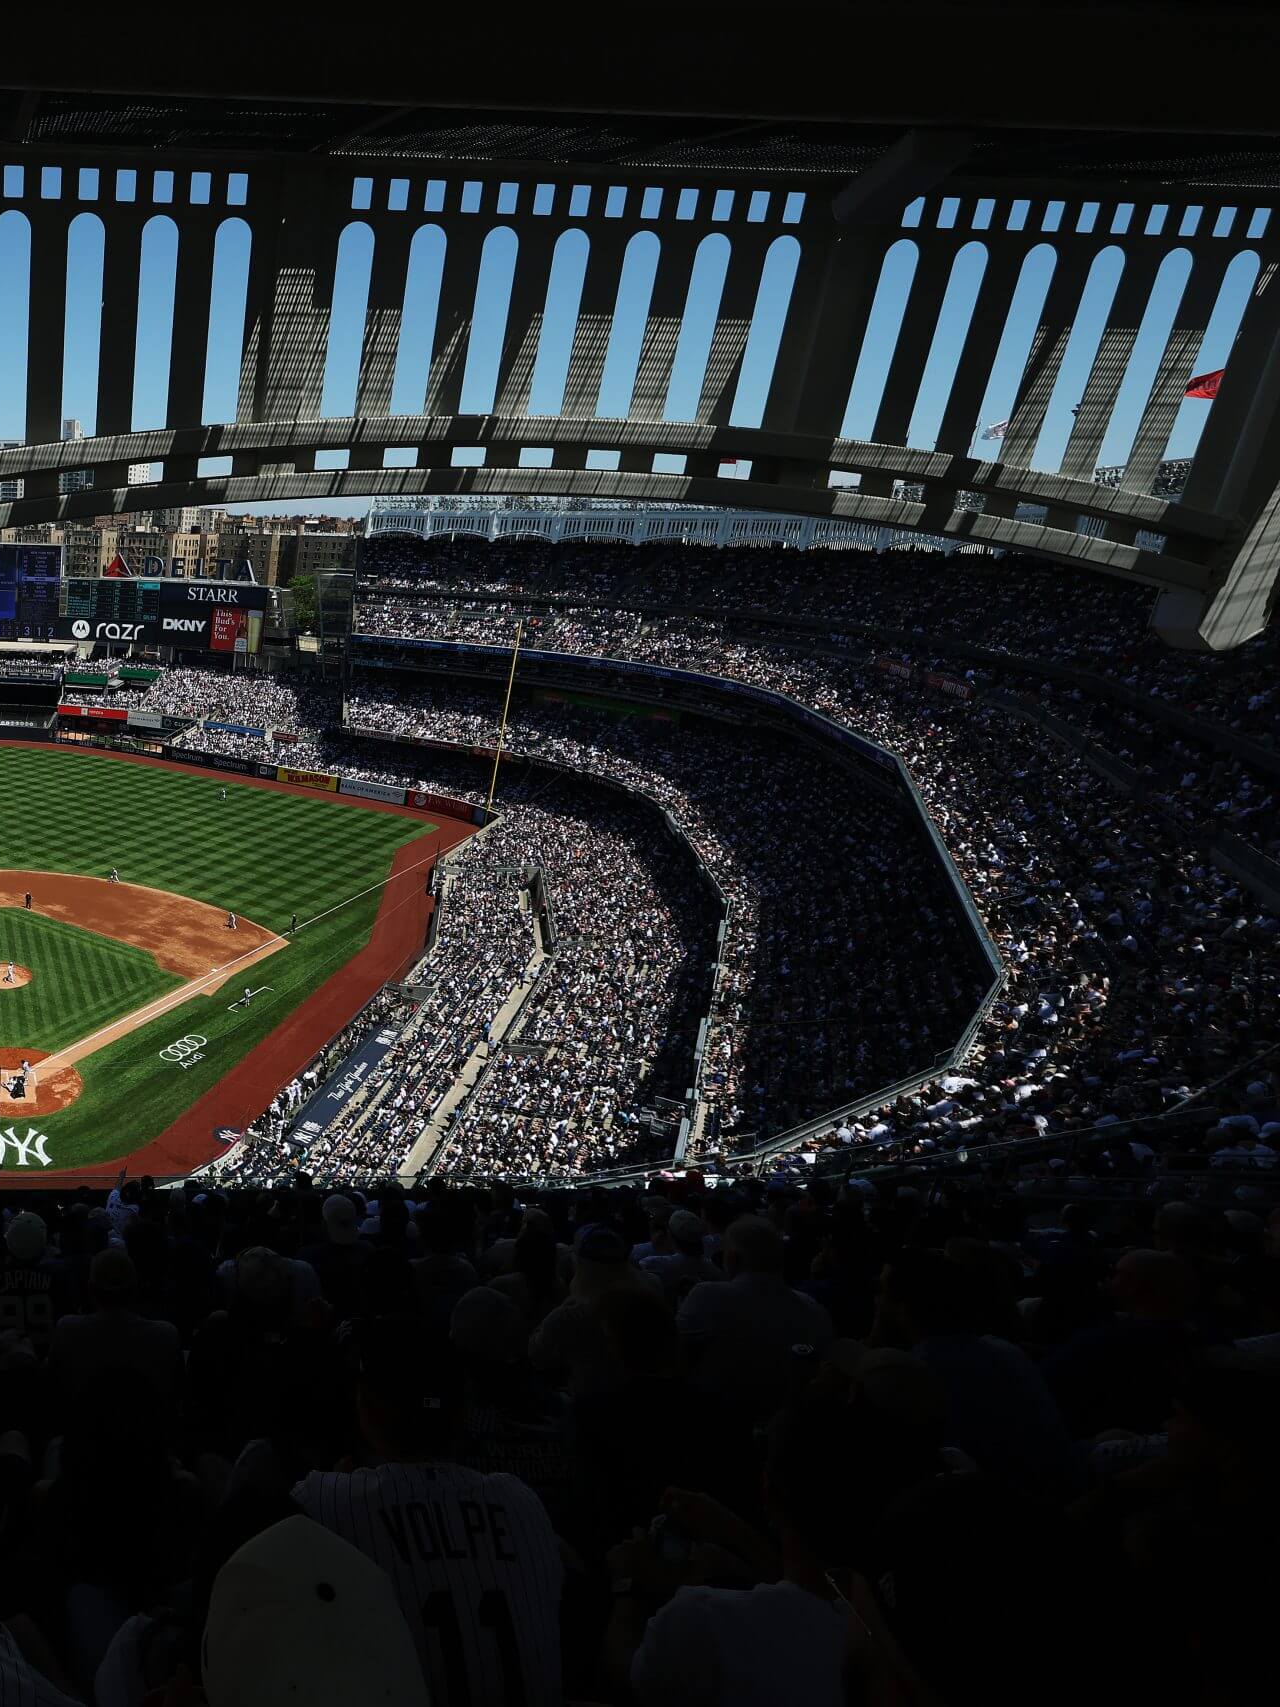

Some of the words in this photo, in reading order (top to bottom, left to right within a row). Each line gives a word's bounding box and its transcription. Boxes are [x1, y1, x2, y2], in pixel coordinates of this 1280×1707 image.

[143, 555, 258, 584] DELTA
[187, 586, 240, 603] STARR
[24, 626, 31, 636] 3
[95, 622, 145, 640] razr
[162, 617, 207, 632] DKNY
[179, 1051, 207, 1070] Audi
[378, 1500, 517, 1565] VOLPE
[422, 1589, 528, 1707] 11
